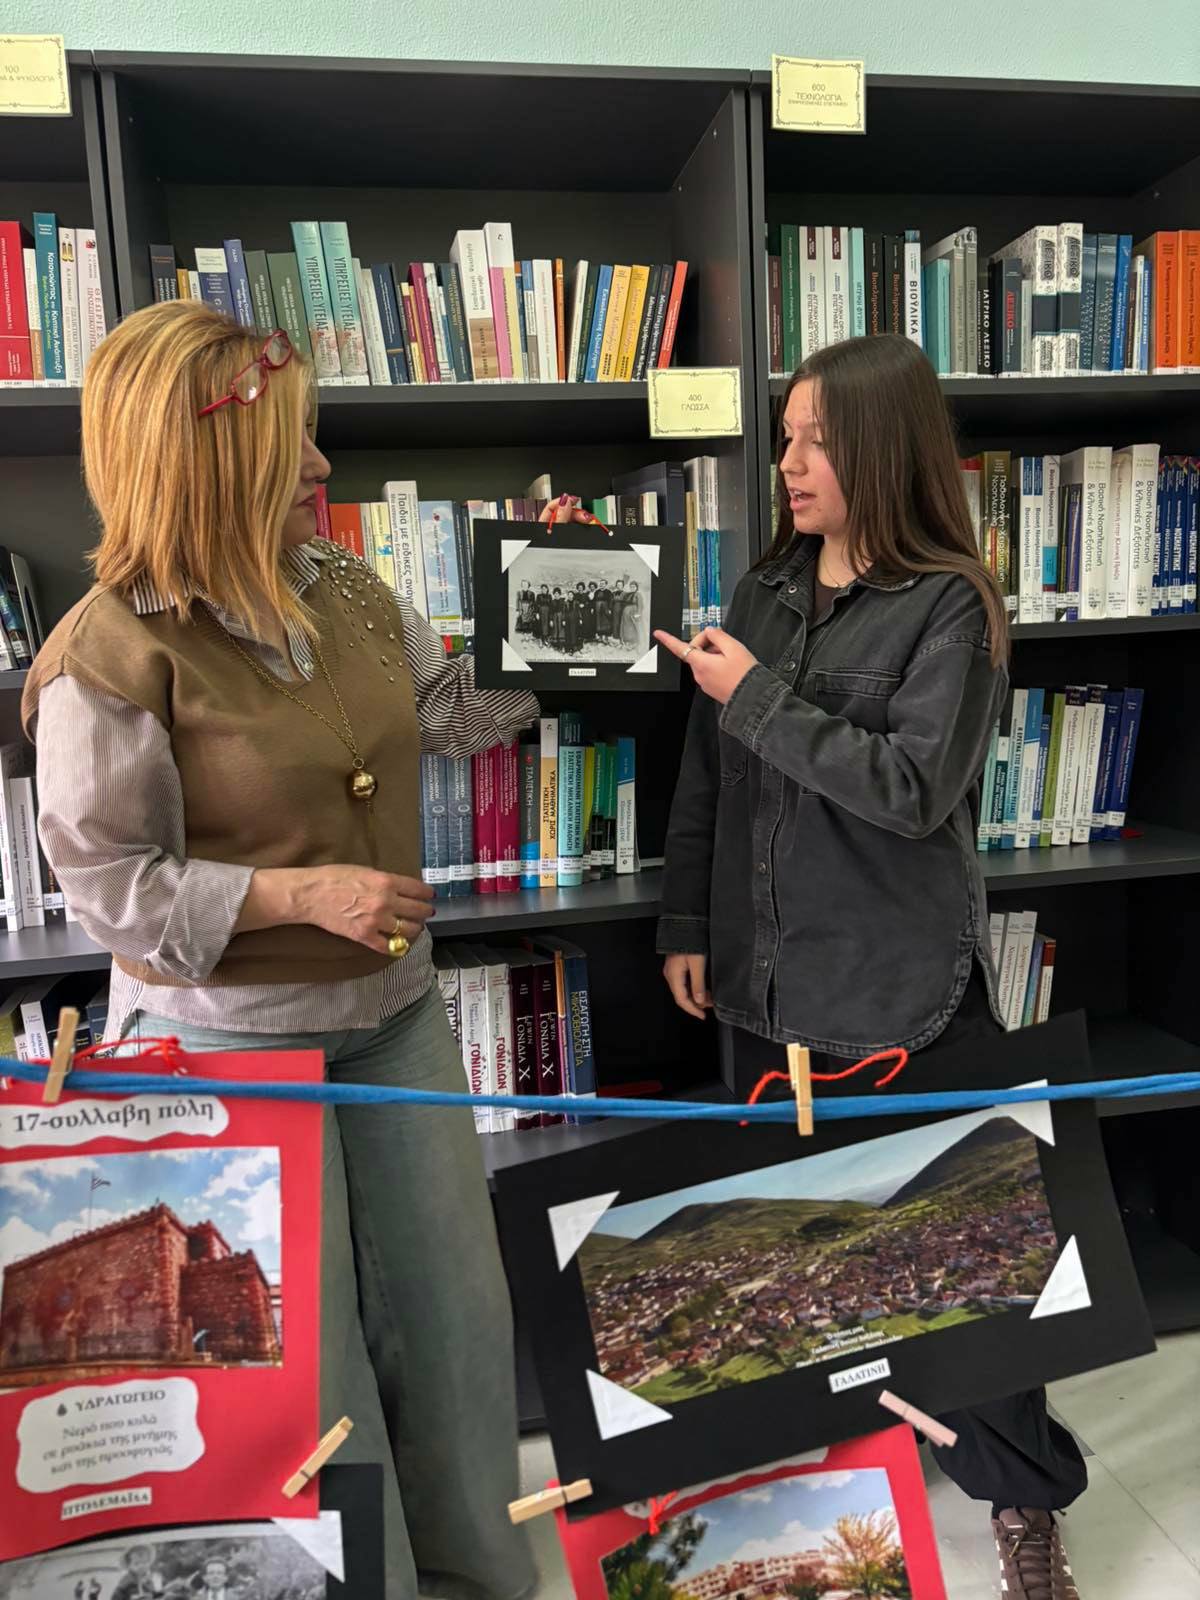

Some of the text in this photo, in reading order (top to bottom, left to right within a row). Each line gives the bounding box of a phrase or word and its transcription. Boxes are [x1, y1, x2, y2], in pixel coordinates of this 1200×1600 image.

[5, 65, 19, 73] 100
[812, 84, 826, 92] 600
[796, 92, 842, 102] ΤΕΧΝΟΛΟΓΙΑ
[305, 256, 321, 301] ΥΠΗΡΕΣΙΕΣ
[334, 257, 350, 301] ΥΠΗΡΕΣΙΕΣ
[47, 252, 56, 300] Κατανοώντας
[53, 339, 62, 373] Ανάπτυξη
[94, 287, 104, 340] ΘΕΩΡΙΕΣ
[312, 304, 328, 331] ΥΓΕΙΑΣ
[340, 304, 356, 332] ΥΓΕΙΑΣ
[871, 271, 881, 336] Βιοπληροφορικ
[892, 273, 900, 335] Βιοπληροφορικ
[909, 280, 920, 335] ΒΙΟΫΛΙΚΑ
[1006, 291, 1016, 328] ΛΕΞΙΚΟ
[983, 332, 991, 368] ΛΕΞΙΚΟ
[681, 403, 710, 411] ΓΛΩΣΣΑ
[688, 394, 702, 402] 400
[1086, 492, 1094, 527] Κλινικές
[1095, 483, 1106, 567] Βασική Νοσηλευτική
[1134, 489, 1142, 524] Κλινικές
[1143, 480, 1154, 564] Βασική Νοσηλευτική
[397, 493, 414, 604] Παιδιά με ειδικές ανάγκ
[1033, 529, 1042, 567] Νοσηλευτική
[1084, 529, 1094, 572] Δεξιότητες
[1132, 525, 1143, 569] Δεξιότητες
[1172, 527, 1182, 571] ΝΟΣΗΛΕΥΤΙΚΗΣ
[1188, 530, 1197, 574] ΝΟΣΗΛΕΥΤΙΚΗΣ
[525, 766, 534, 807] ΣΤΑΤΙΣΤΙΚΗ
[566, 787, 574, 822] ΜΗΧΑΝΙΚΗ
[573, 751, 582, 849] ΕΦΑΡΜΟΣΜΕΝΗ ΣΤΑΤΙΣΤΙΚΗ ΚΑΙ
[566, 823, 574, 851] ΜΑΘΗΣΗ
[570, 991, 583, 1066] ΜΙΚΡΟΒΙΟΛΟΓΙΑ
[579, 990, 592, 1057] ΕΙΣΑΓΩΓΗ ΣΤΗ
[495, 1037, 507, 1090] ΓΟΝΙΔΙΩΝ
[516, 1016, 530, 1082] ΓΟΝΙΔΙΑ X
[539, 1013, 554, 1078] ΓΟΝΙΔΙΑ X
[470, 1043, 482, 1096] ΓΟΝΙΔΙΩΝ
[158, 1098, 214, 1120] πόλη
[834, 1363, 886, 1388] ΓΑΛΑΤΙΝΗ
[75, 1390, 166, 1412] ΥΔΡΑΓΩΓΕΙΟ
[63, 1424, 97, 1440] Νερό
[100, 1420, 125, 1432] που
[110, 1434, 130, 1447] της
[132, 1429, 178, 1444] μνήμης
[51, 1461, 73, 1475] και
[75, 1456, 97, 1469] της
